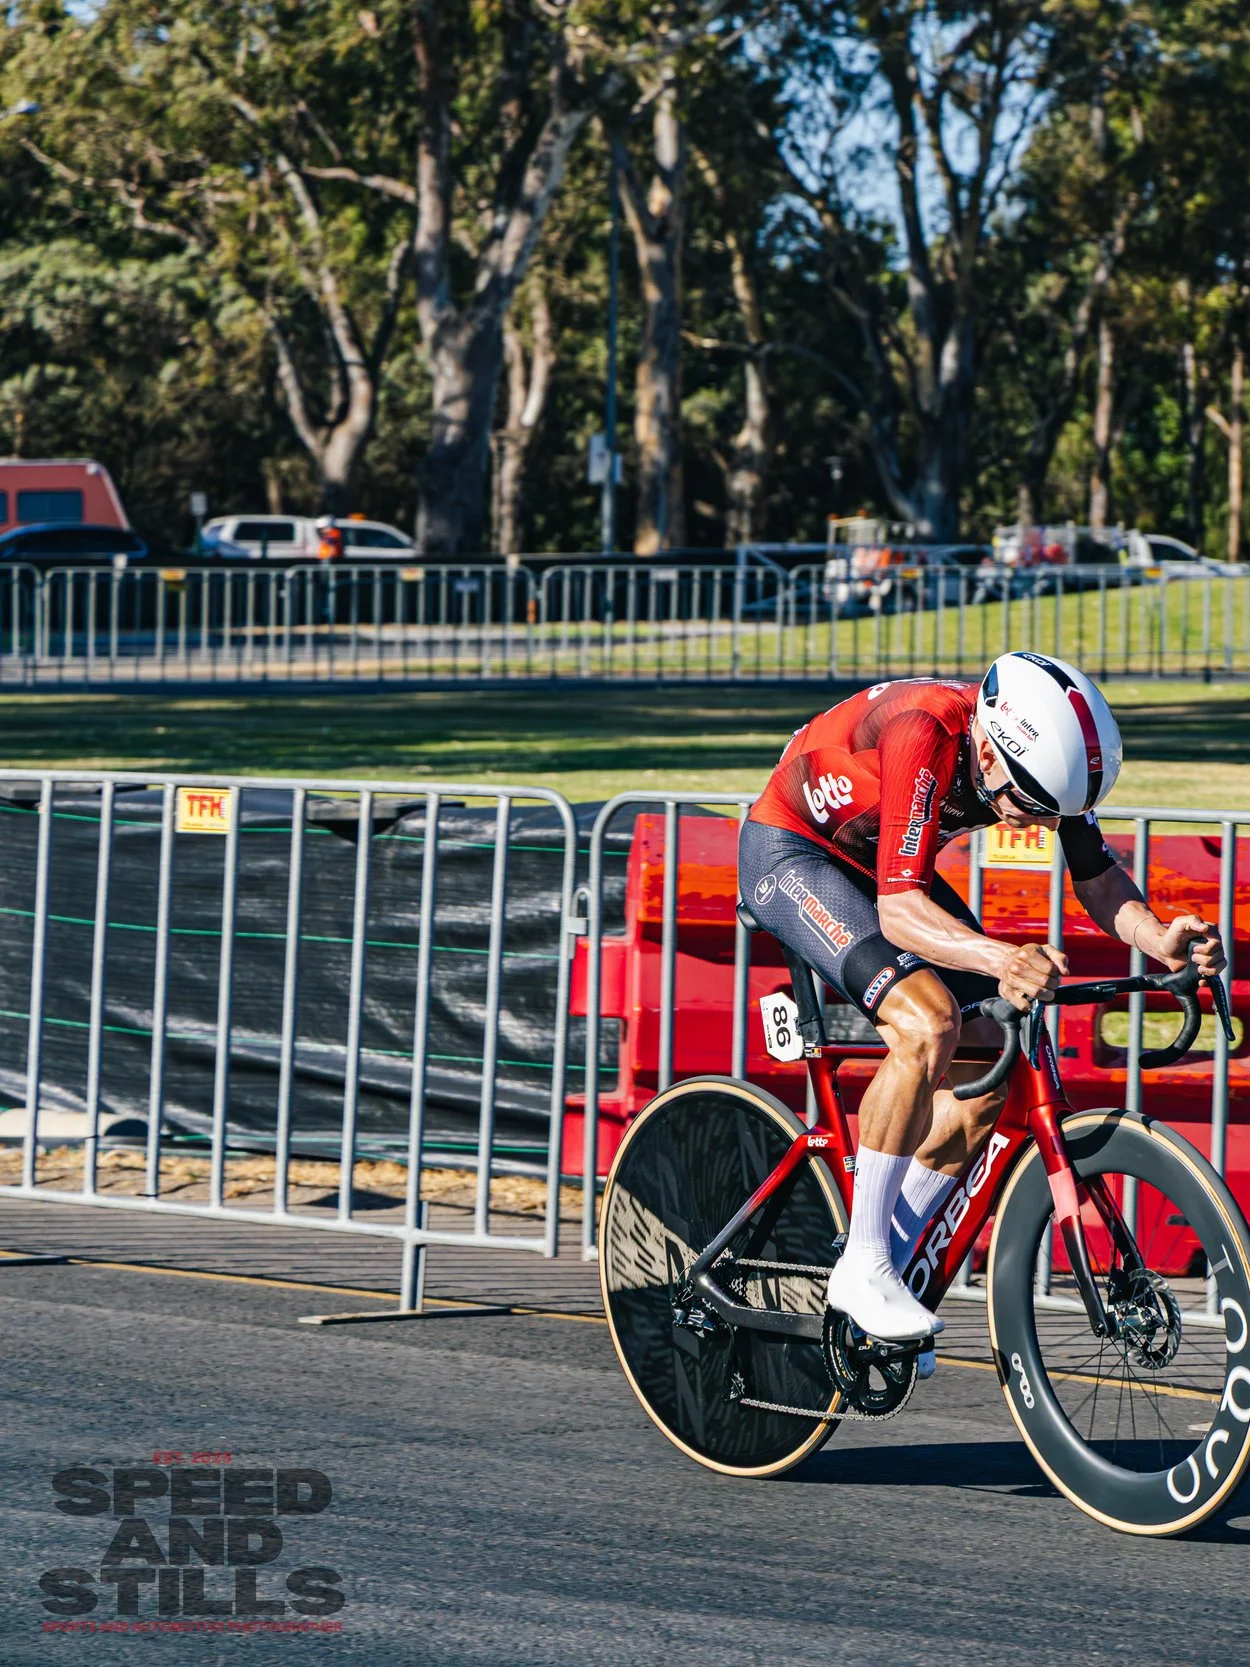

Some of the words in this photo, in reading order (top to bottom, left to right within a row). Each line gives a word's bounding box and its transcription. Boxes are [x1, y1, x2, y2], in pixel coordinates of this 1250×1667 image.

[187, 795, 223, 818] TFH
[802, 772, 853, 824] lotto
[995, 823, 1042, 849] TFH
[773, 1005, 791, 1048] 86
[807, 1136, 828, 1147] lotto
[907, 1131, 1011, 1300] ORBEA
